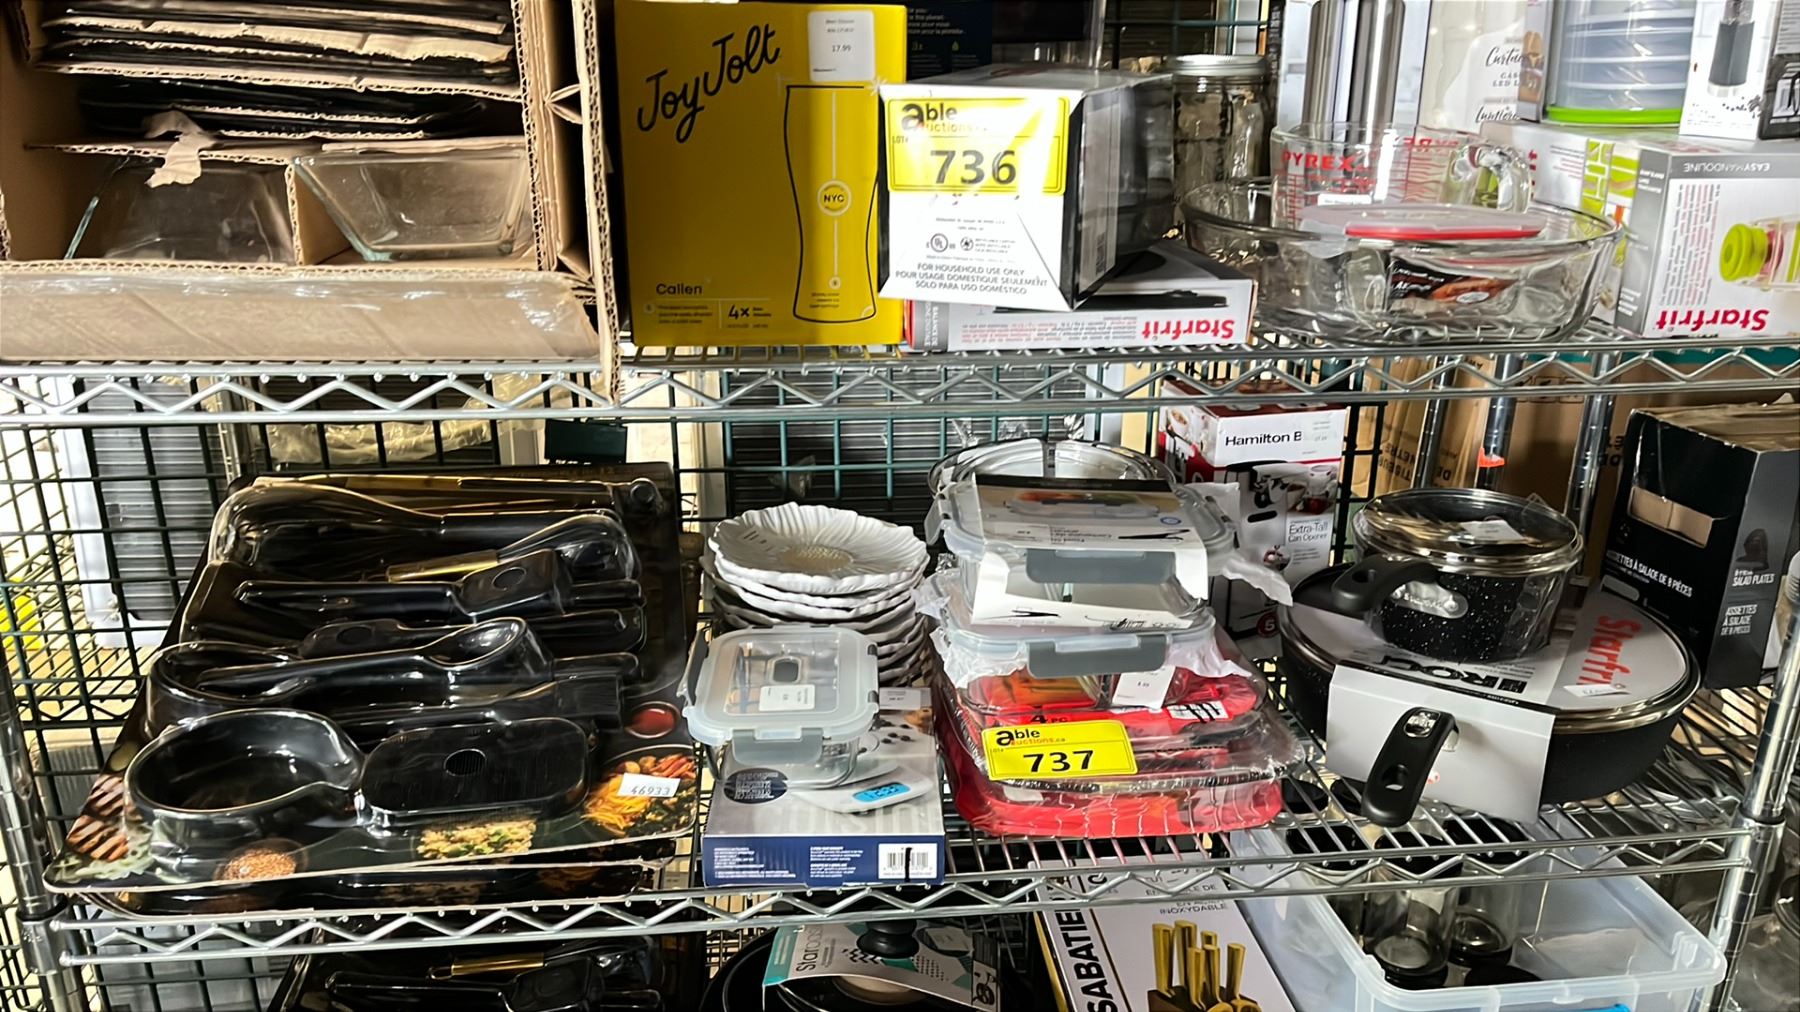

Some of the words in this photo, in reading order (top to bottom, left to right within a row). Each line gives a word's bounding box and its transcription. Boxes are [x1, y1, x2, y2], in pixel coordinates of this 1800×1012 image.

[637, 23, 781, 144] JoyJolt
[930, 150, 1017, 185] 736
[1282, 151, 1356, 171] PYREX
[823, 193, 845, 203] NYC
[917, 262, 934, 272] FOR
[935, 263, 985, 275] HOUSEHOLD
[986, 267, 1001, 276] USE
[1003, 267, 1025, 277] ONLY
[896, 270, 918, 280] POUR
[918, 271, 945, 281] USAGE
[1000, 277, 1048, 287] SEULEMENT
[656, 283, 703, 295] Callen
[938, 281, 959, 291] PARA
[960, 283, 978, 292] USO
[1656, 309, 1771, 332] Starfrit
[1142, 319, 1235, 340] Starfrit
[1225, 432, 1290, 447] Hamilton
[1289, 521, 1329, 535] Extra-Tall
[1658, 572, 1667, 584] DE
[1732, 576, 1752, 586] SALAD
[1752, 573, 1775, 585] PLATES
[1264, 619, 1275, 631] 5
[1576, 615, 1643, 685] Starfri
[996, 729, 1041, 747] able
[1023, 749, 1095, 773] 737
[1159, 903, 1227, 915] INOXYDABLE
